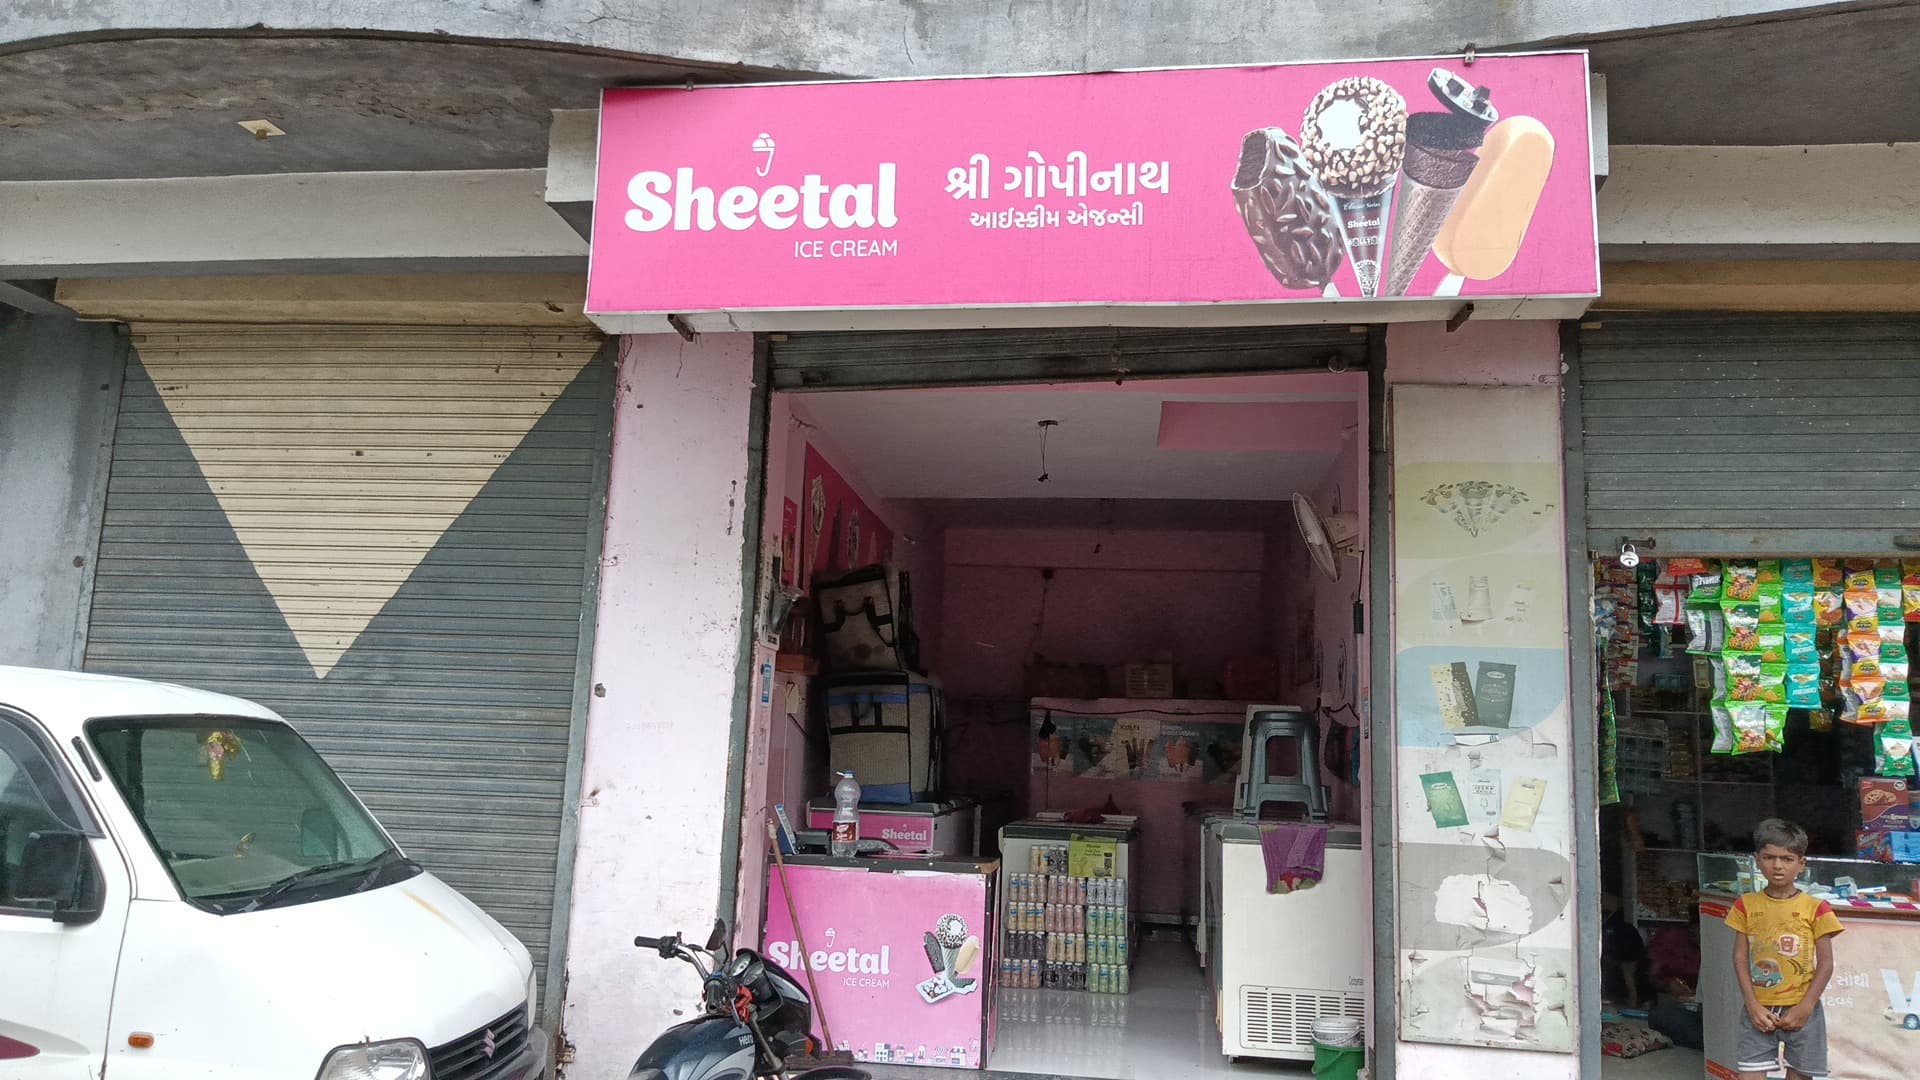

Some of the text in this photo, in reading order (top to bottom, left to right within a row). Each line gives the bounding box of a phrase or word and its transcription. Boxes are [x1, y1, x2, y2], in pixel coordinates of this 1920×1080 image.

[944, 151, 1171, 200] શ્રી ગોપીનાથ
[624, 162, 898, 231] Sheetal
[969, 201, 1145, 229] આઈસ્ક્રીમ એજન્સી
[1347, 217, 1380, 228] Sheetal
[793, 239, 898, 258] ICE CREAM
[881, 829, 927, 841] Sheetal
[768, 941, 890, 975] Sheetal
[843, 977, 890, 989] ICE CREAM
